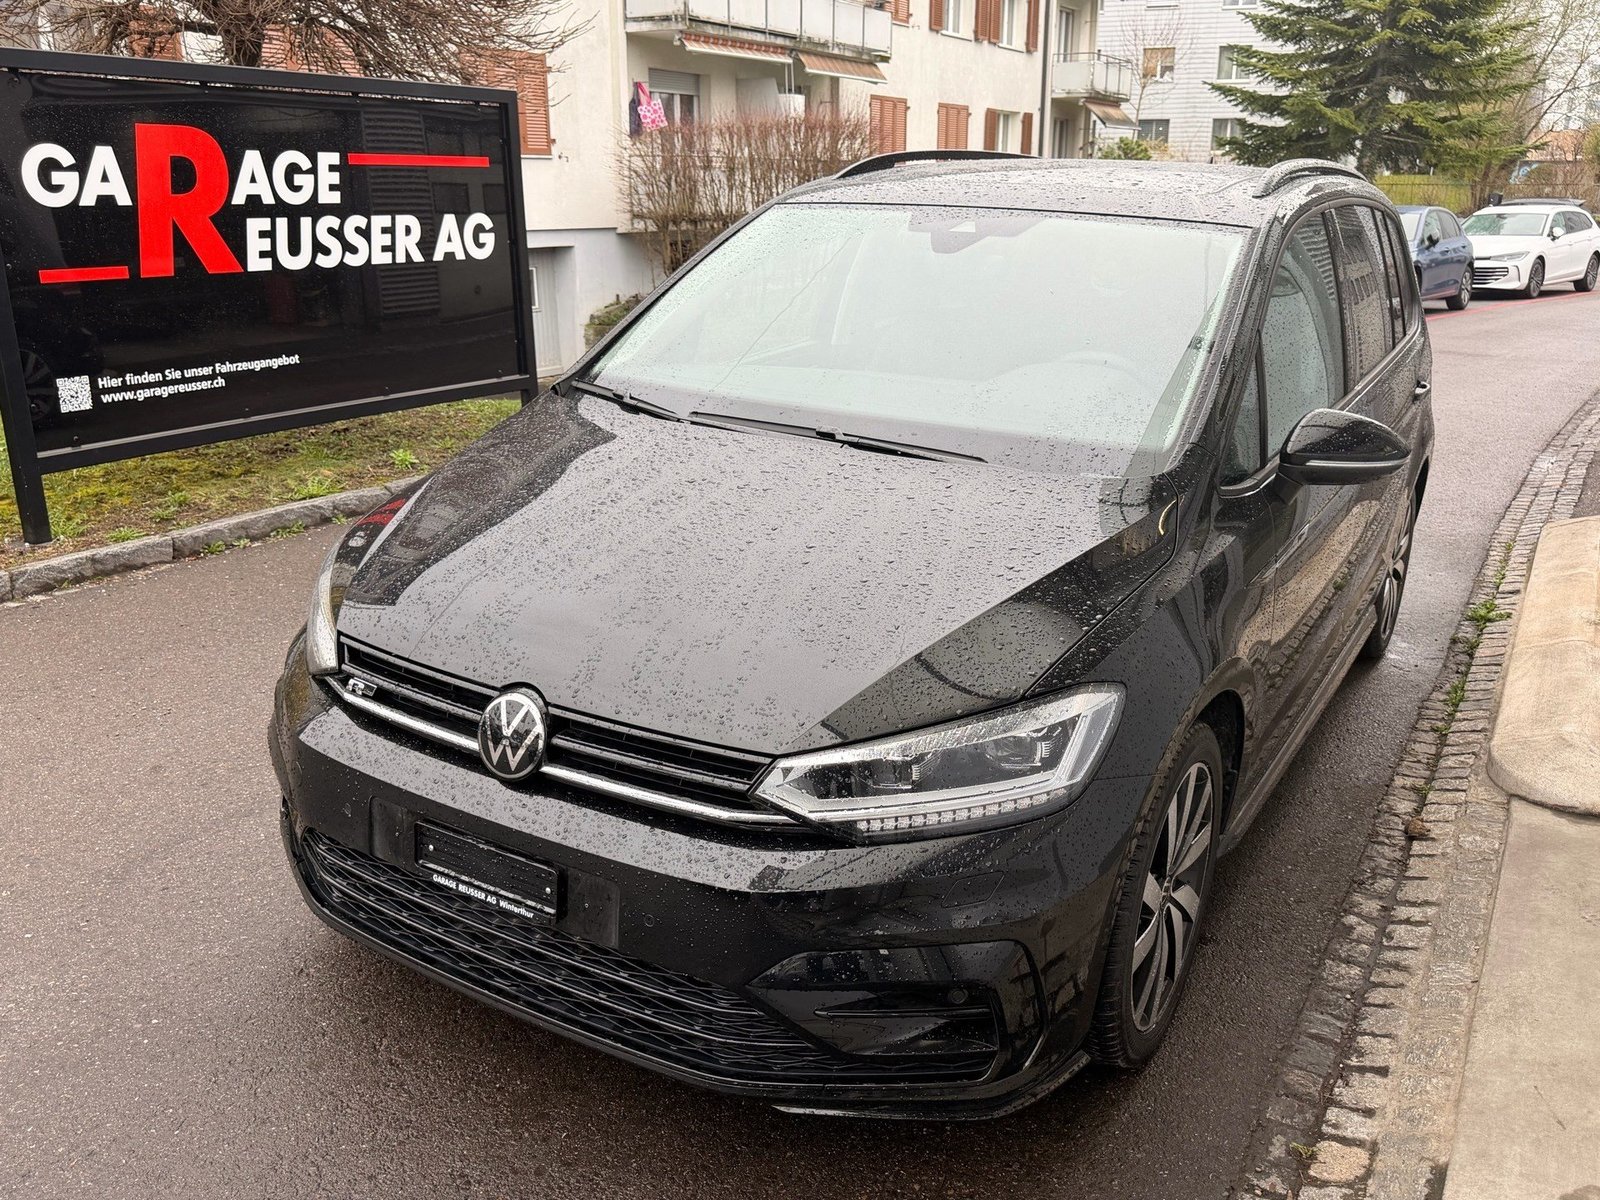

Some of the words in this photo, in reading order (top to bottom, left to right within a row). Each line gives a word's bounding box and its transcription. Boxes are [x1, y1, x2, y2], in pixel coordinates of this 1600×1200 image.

[21, 123, 341, 278] GARAGE
[433, 212, 496, 261] AG
[98, 376, 122, 389] Hier
[125, 372, 162, 386] finden
[165, 368, 182, 381] Sie
[185, 365, 214, 378] unser
[215, 354, 300, 374] Fahrzeugangebot
[101, 376, 226, 403] www.garagereusser.ch
[432, 874, 457, 889] GARAGE
[458, 884, 486, 900] REUSSER
[486, 895, 497, 904] AG
[499, 899, 534, 918] Winterthur
